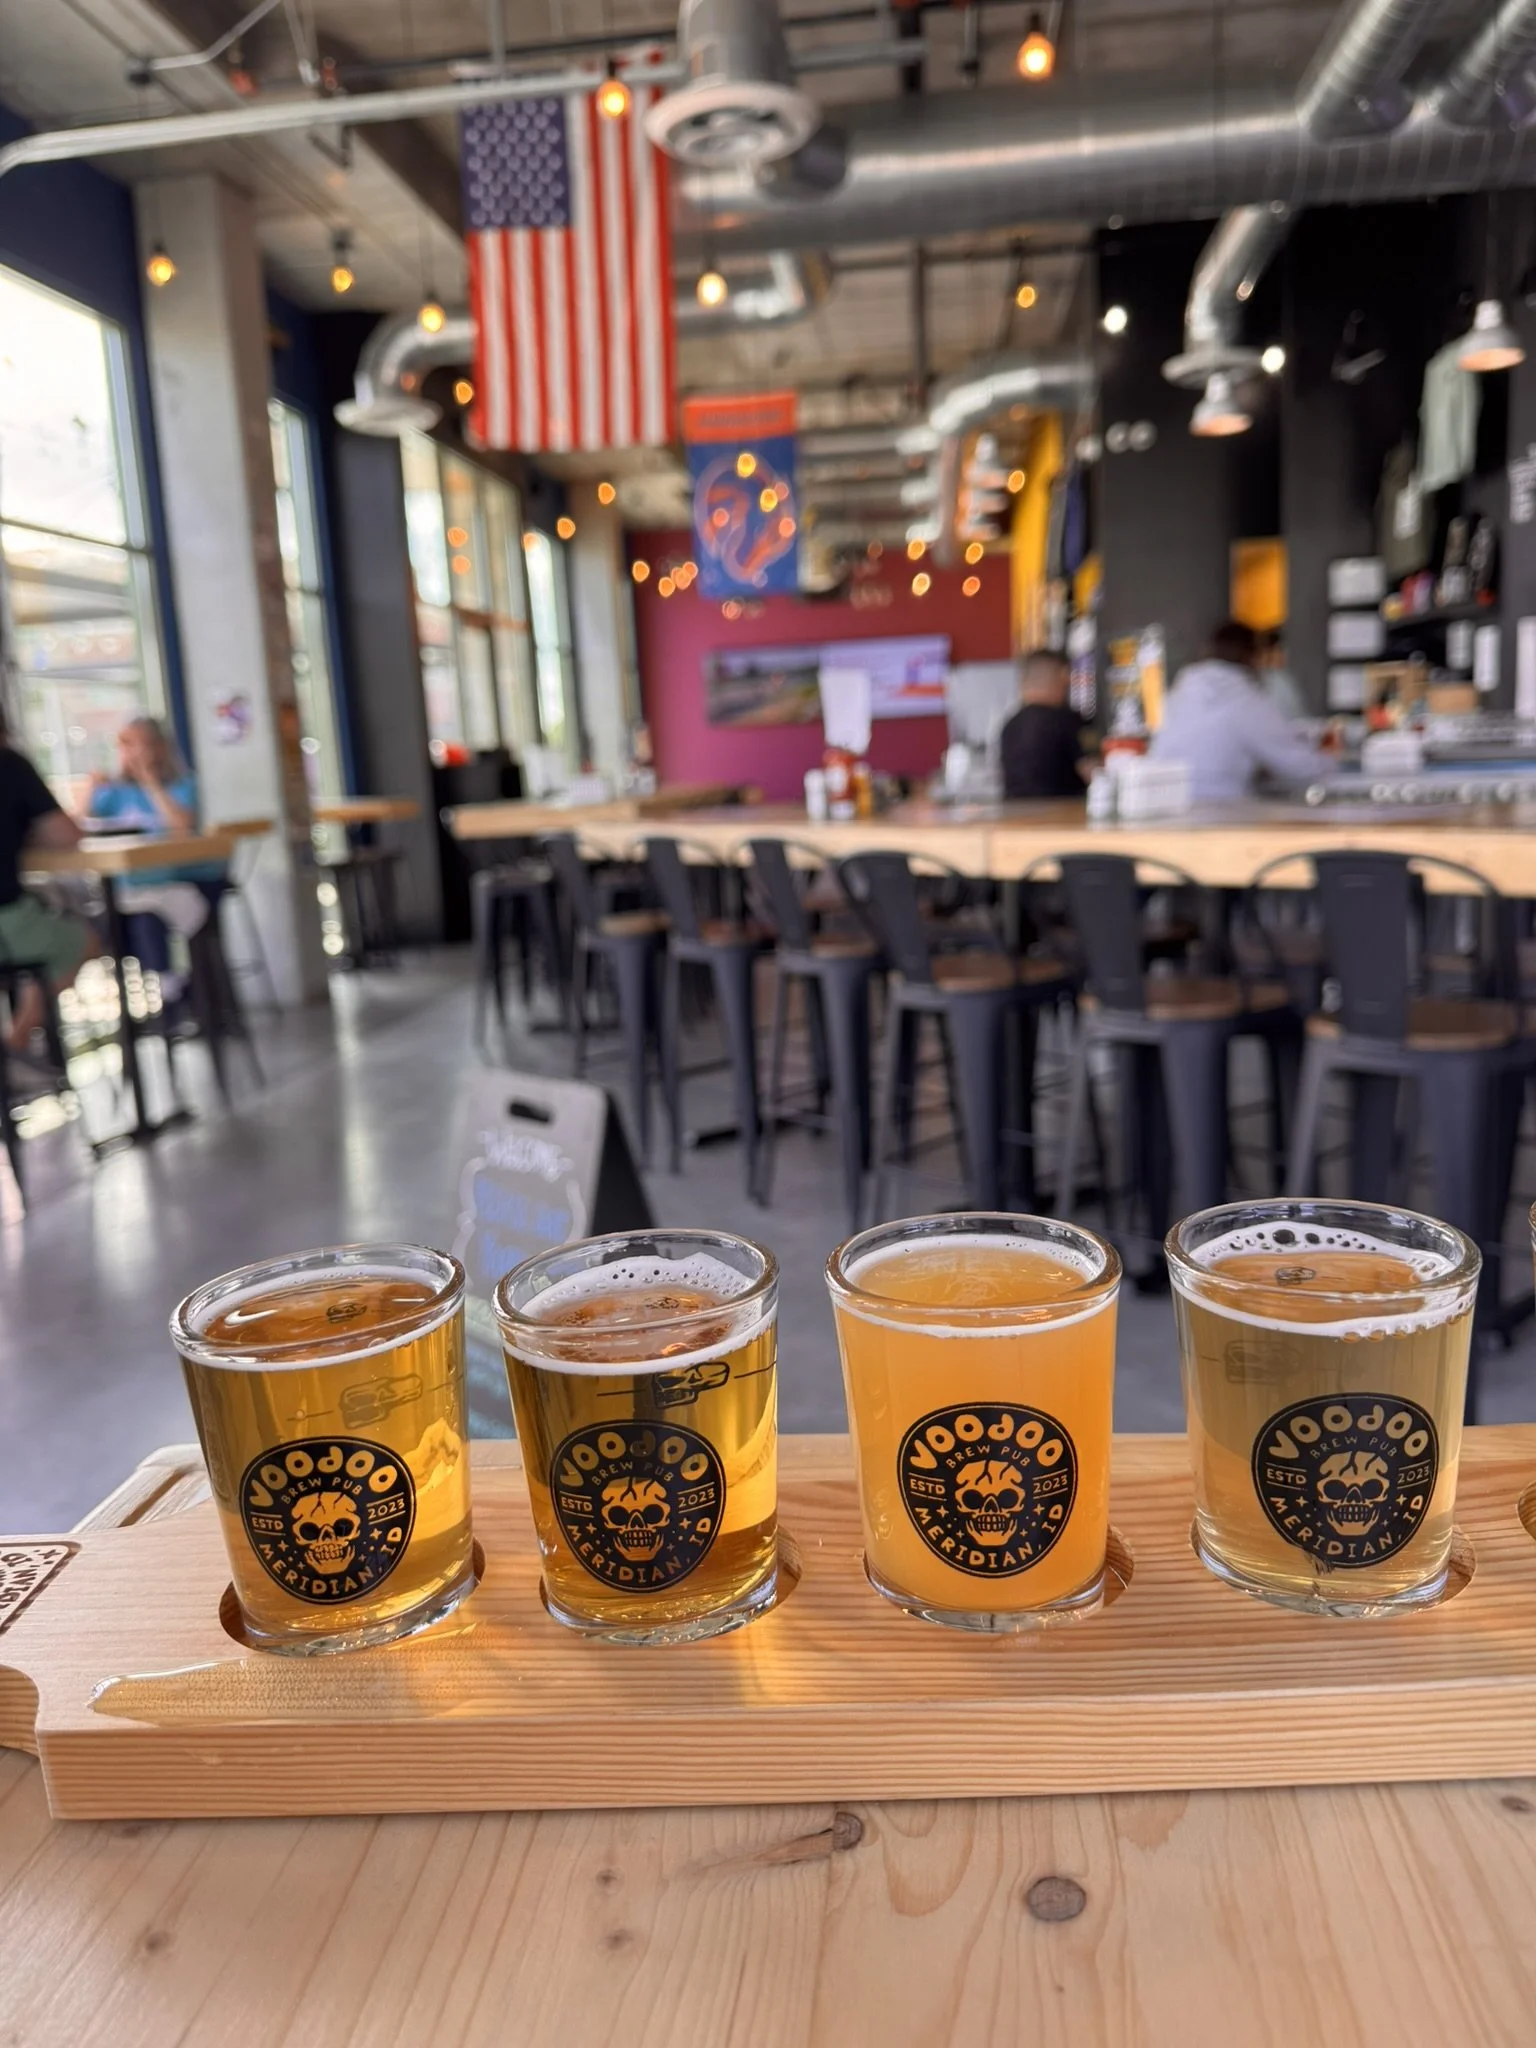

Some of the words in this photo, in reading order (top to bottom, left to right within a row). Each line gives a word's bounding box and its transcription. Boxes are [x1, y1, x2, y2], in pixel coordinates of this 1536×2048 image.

[945, 1444, 991, 1469] BREW
[1000, 1444, 1031, 1468] PUB
[1309, 1435, 1359, 1460] BREW
[1369, 1436, 1398, 1458] PUB
[591, 1461, 634, 1486] BREW
[644, 1462, 675, 1483] PUB
[910, 1478, 946, 1496] ESTD
[1033, 1474, 1069, 1494] 2023
[1266, 1468, 1308, 1486] ESTD
[1397, 1465, 1431, 1484] 2023
[280, 1477, 322, 1505] BREW
[332, 1476, 363, 1496] PUB
[560, 1496, 593, 1512] ESTD
[678, 1489, 716, 1508] 2023
[251, 1516, 285, 1532] ESTD
[368, 1497, 406, 1520] 2023
[1041, 1503, 1064, 1534] ID
[1403, 1494, 1424, 1525] ID
[381, 1525, 403, 1556] ID
[689, 1516, 712, 1547] ID
